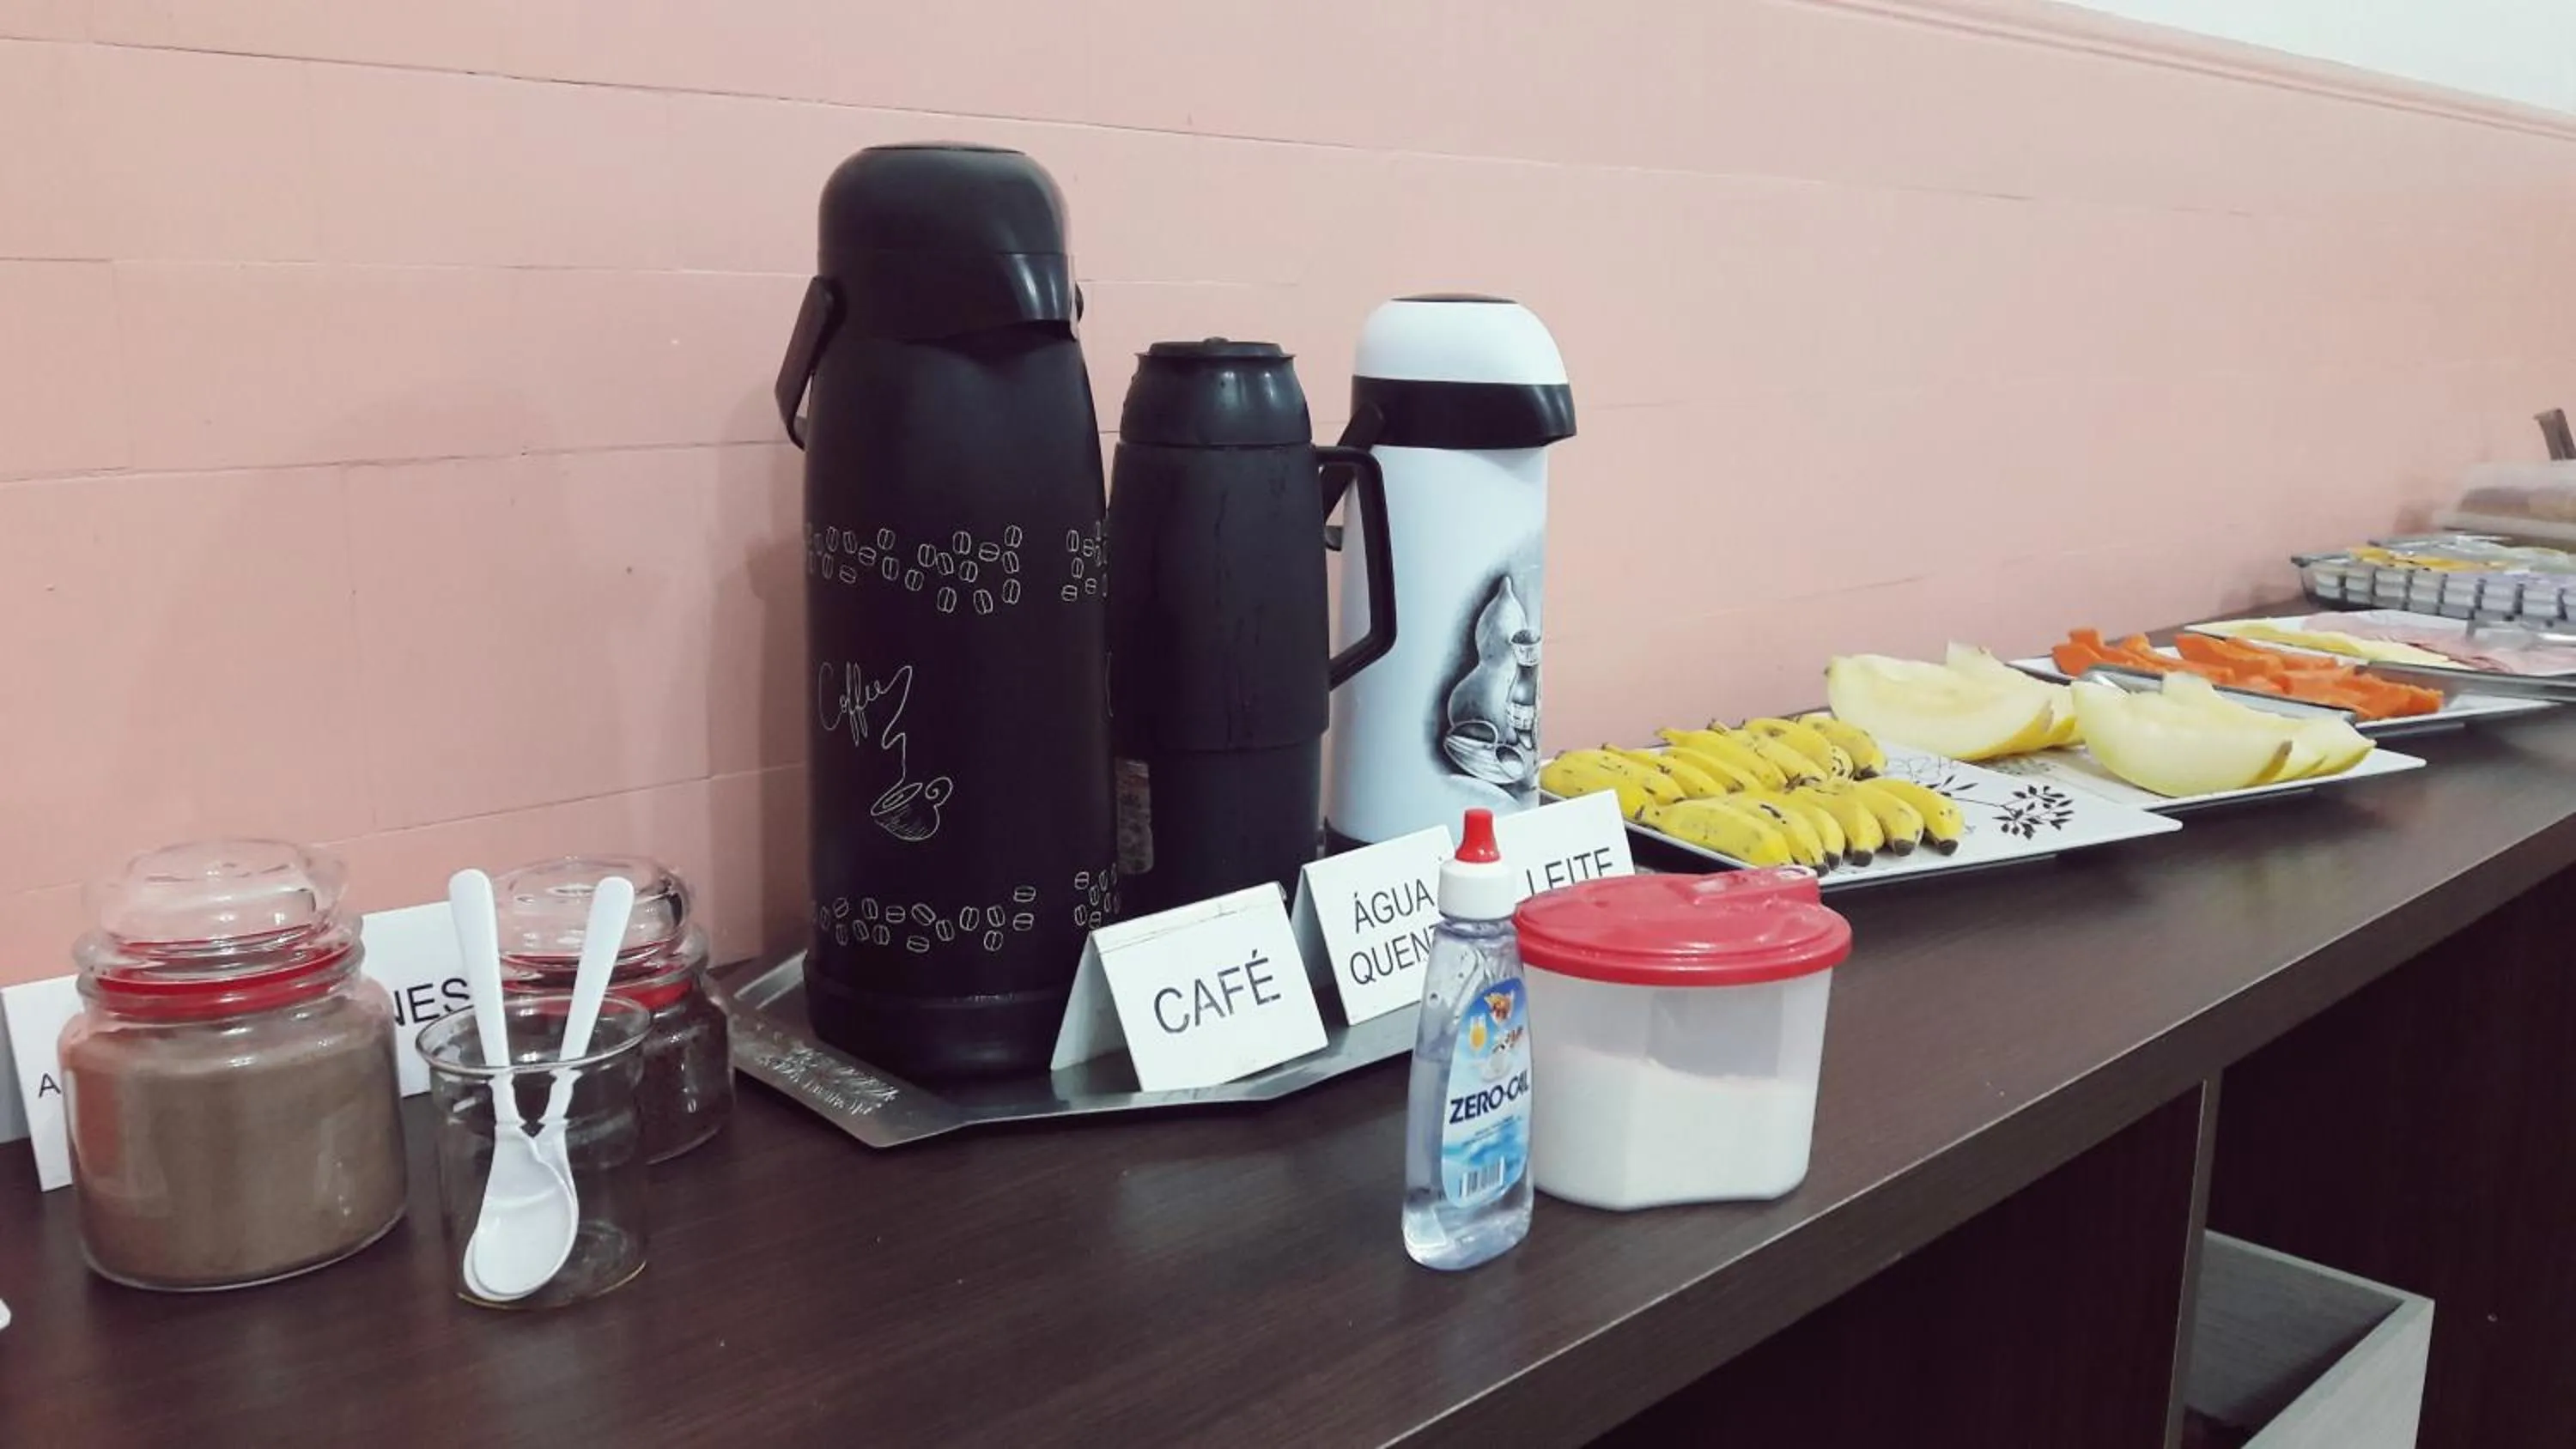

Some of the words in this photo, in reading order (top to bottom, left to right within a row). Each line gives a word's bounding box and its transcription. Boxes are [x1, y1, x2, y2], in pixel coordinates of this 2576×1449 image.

[818, 660, 883, 747] Coffee
[1353, 878, 1435, 934] ÁGUA
[1350, 923, 1438, 985] QUEN
[1154, 949, 1281, 1034] CAFÉ
